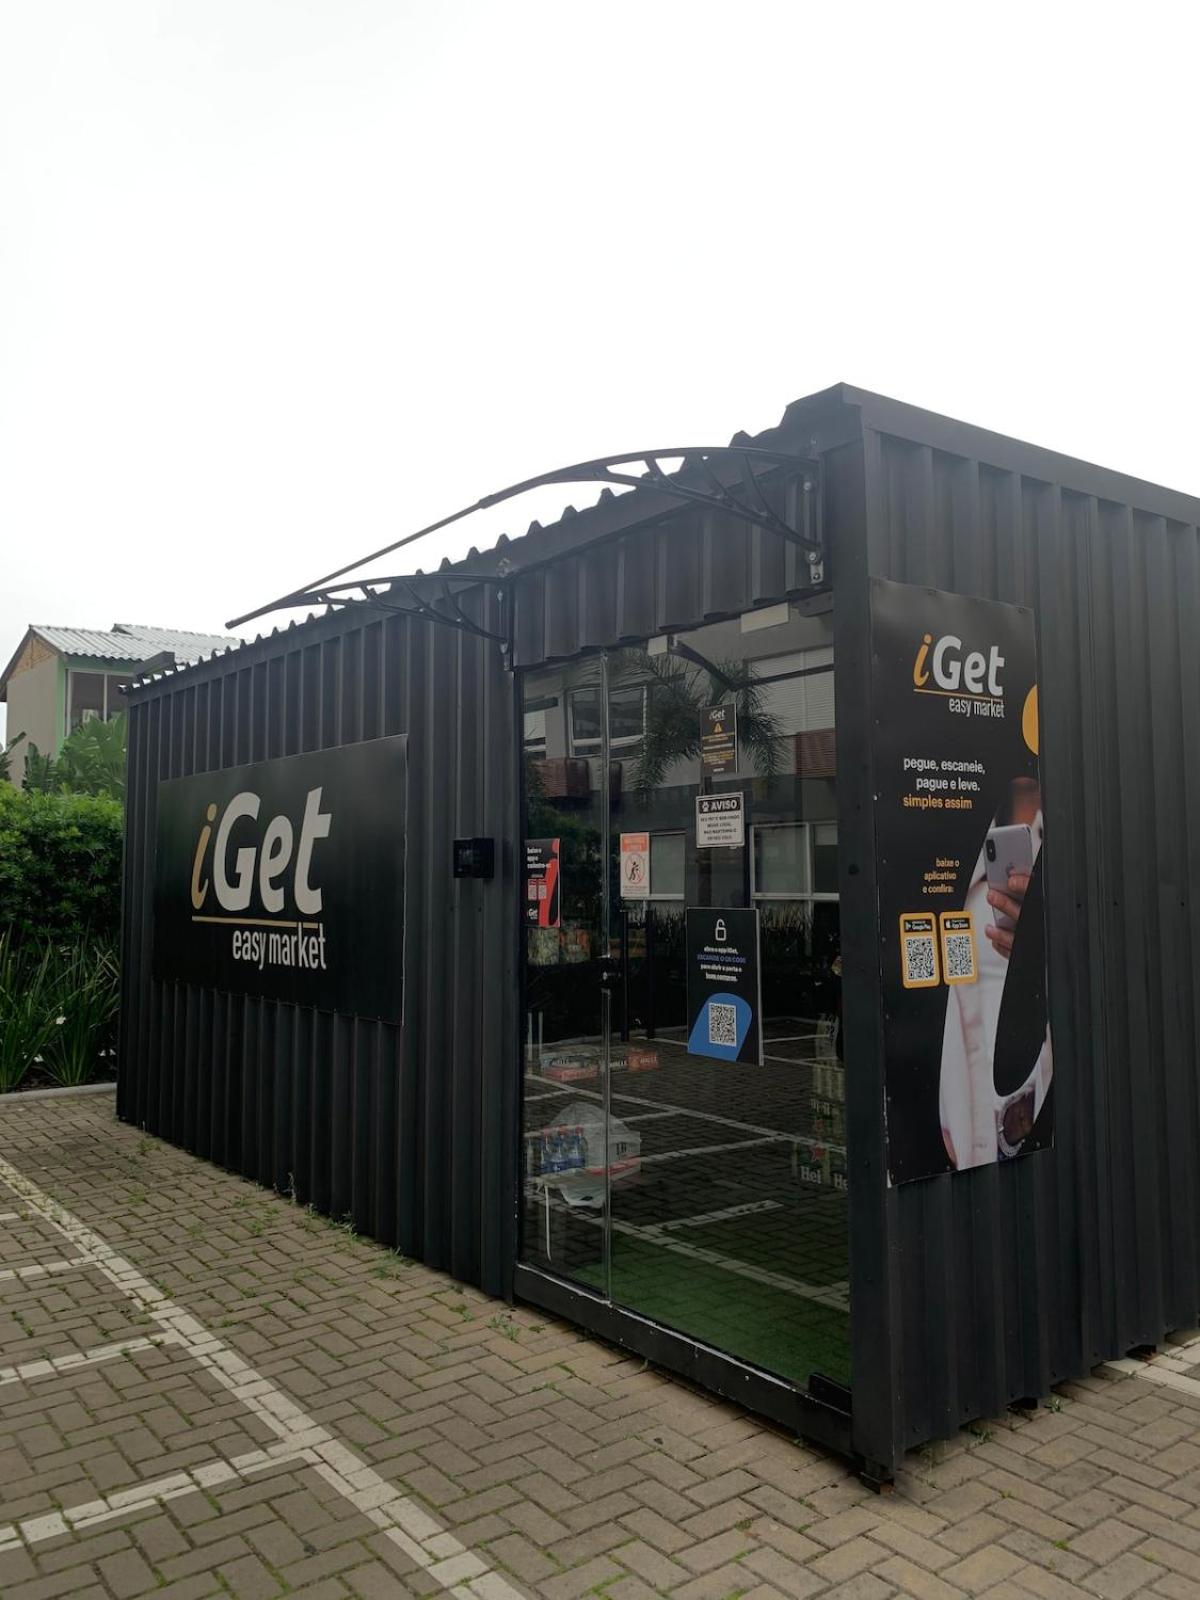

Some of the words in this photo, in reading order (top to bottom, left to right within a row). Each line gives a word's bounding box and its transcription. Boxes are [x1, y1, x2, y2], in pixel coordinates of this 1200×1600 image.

[912, 633, 1005, 697] iGet
[949, 697, 971, 717] easy
[973, 699, 1005, 718] market
[903, 757, 939, 772] pegue,
[941, 759, 986, 775] escaneie,
[916, 778, 948, 792] pague
[950, 781, 957, 790] e
[711, 799, 738, 812] AVISO
[903, 794, 943, 810] simples
[944, 796, 973, 810] assim
[191, 786, 332, 915] iGet
[923, 870, 957, 882] aplicativo
[232, 929, 266, 970] easy
[268, 921, 327, 970] market
